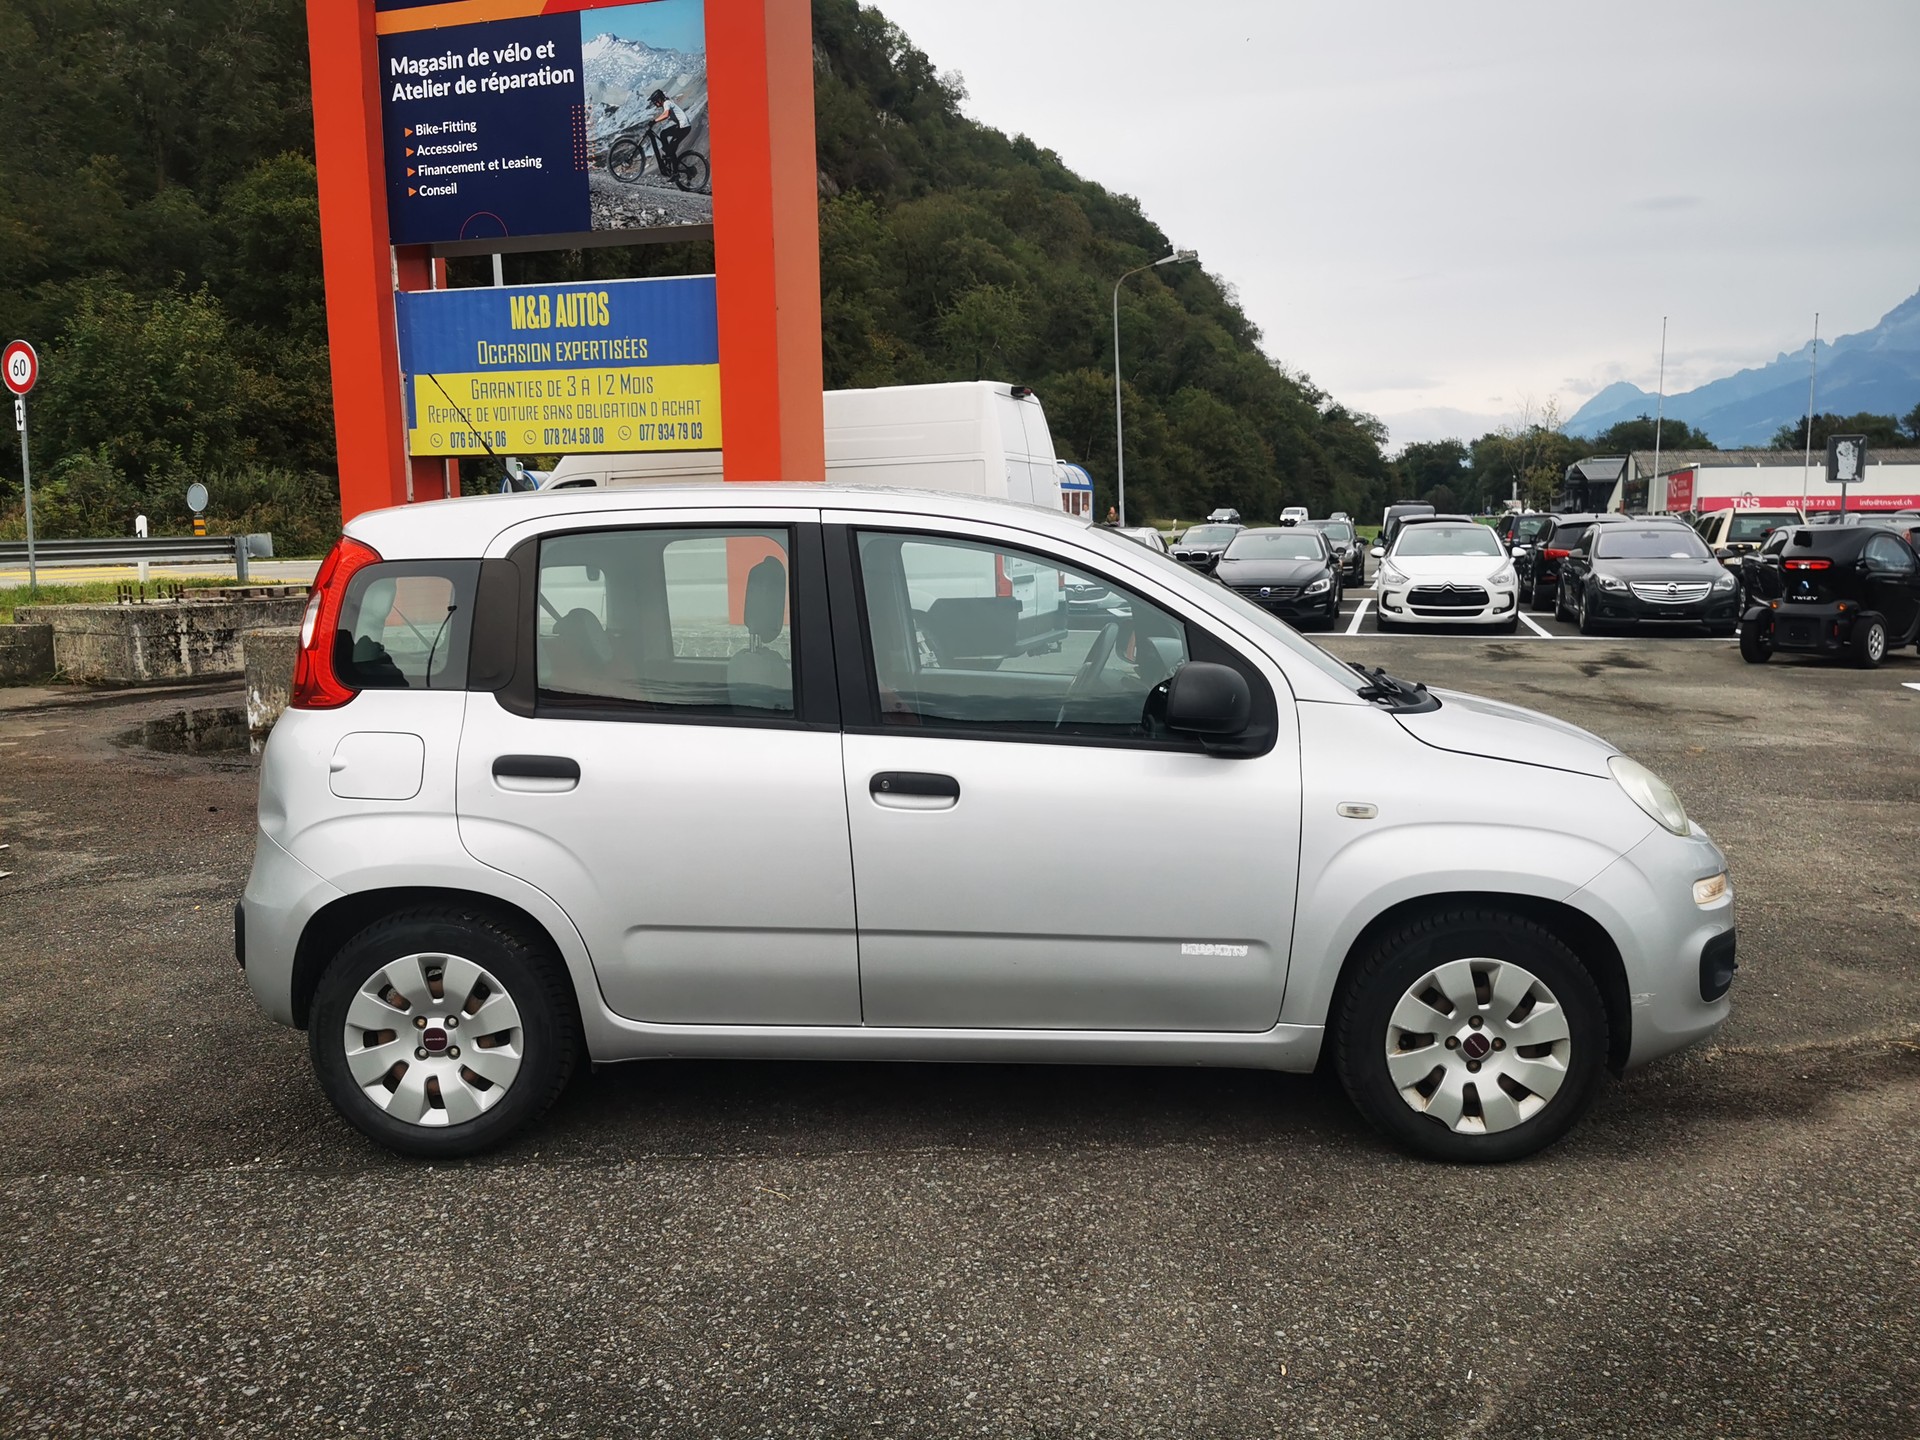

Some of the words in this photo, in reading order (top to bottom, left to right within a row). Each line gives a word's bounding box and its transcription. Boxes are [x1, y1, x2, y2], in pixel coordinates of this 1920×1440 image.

[390, 51, 464, 77] Magasin
[467, 47, 490, 68] de
[493, 42, 532, 64] vélo
[535, 40, 556, 59] et
[391, 78, 451, 102] Atelier
[454, 75, 477, 95] de
[480, 65, 575, 94] réparation
[415, 120, 477, 136] Bike-Fitting
[416, 140, 478, 156] Accessoires
[418, 160, 486, 177] Financement
[487, 159, 500, 171] et
[502, 155, 543, 170] Leasing
[419, 182, 458, 197] Conseil
[510, 294, 551, 330] M&B
[555, 291, 610, 328] AUTOS
[13, 358, 26, 377] 60
[566, 375, 577, 397] 3
[543, 404, 573, 420] SANS
[576, 402, 647, 419] OBLIGATION
[662, 399, 702, 416] ACHAT
[450, 431, 466, 448] 076
[495, 430, 507, 447] 06
[543, 428, 561, 446] 078
[562, 427, 578, 445] 214
[579, 427, 591, 444] 58
[592, 426, 605, 444] 08
[639, 423, 656, 441] 077
[657, 422, 676, 440] 934
[677, 422, 689, 440] 79
[690, 421, 703, 439] 03
[1730, 497, 1761, 509] TNS
